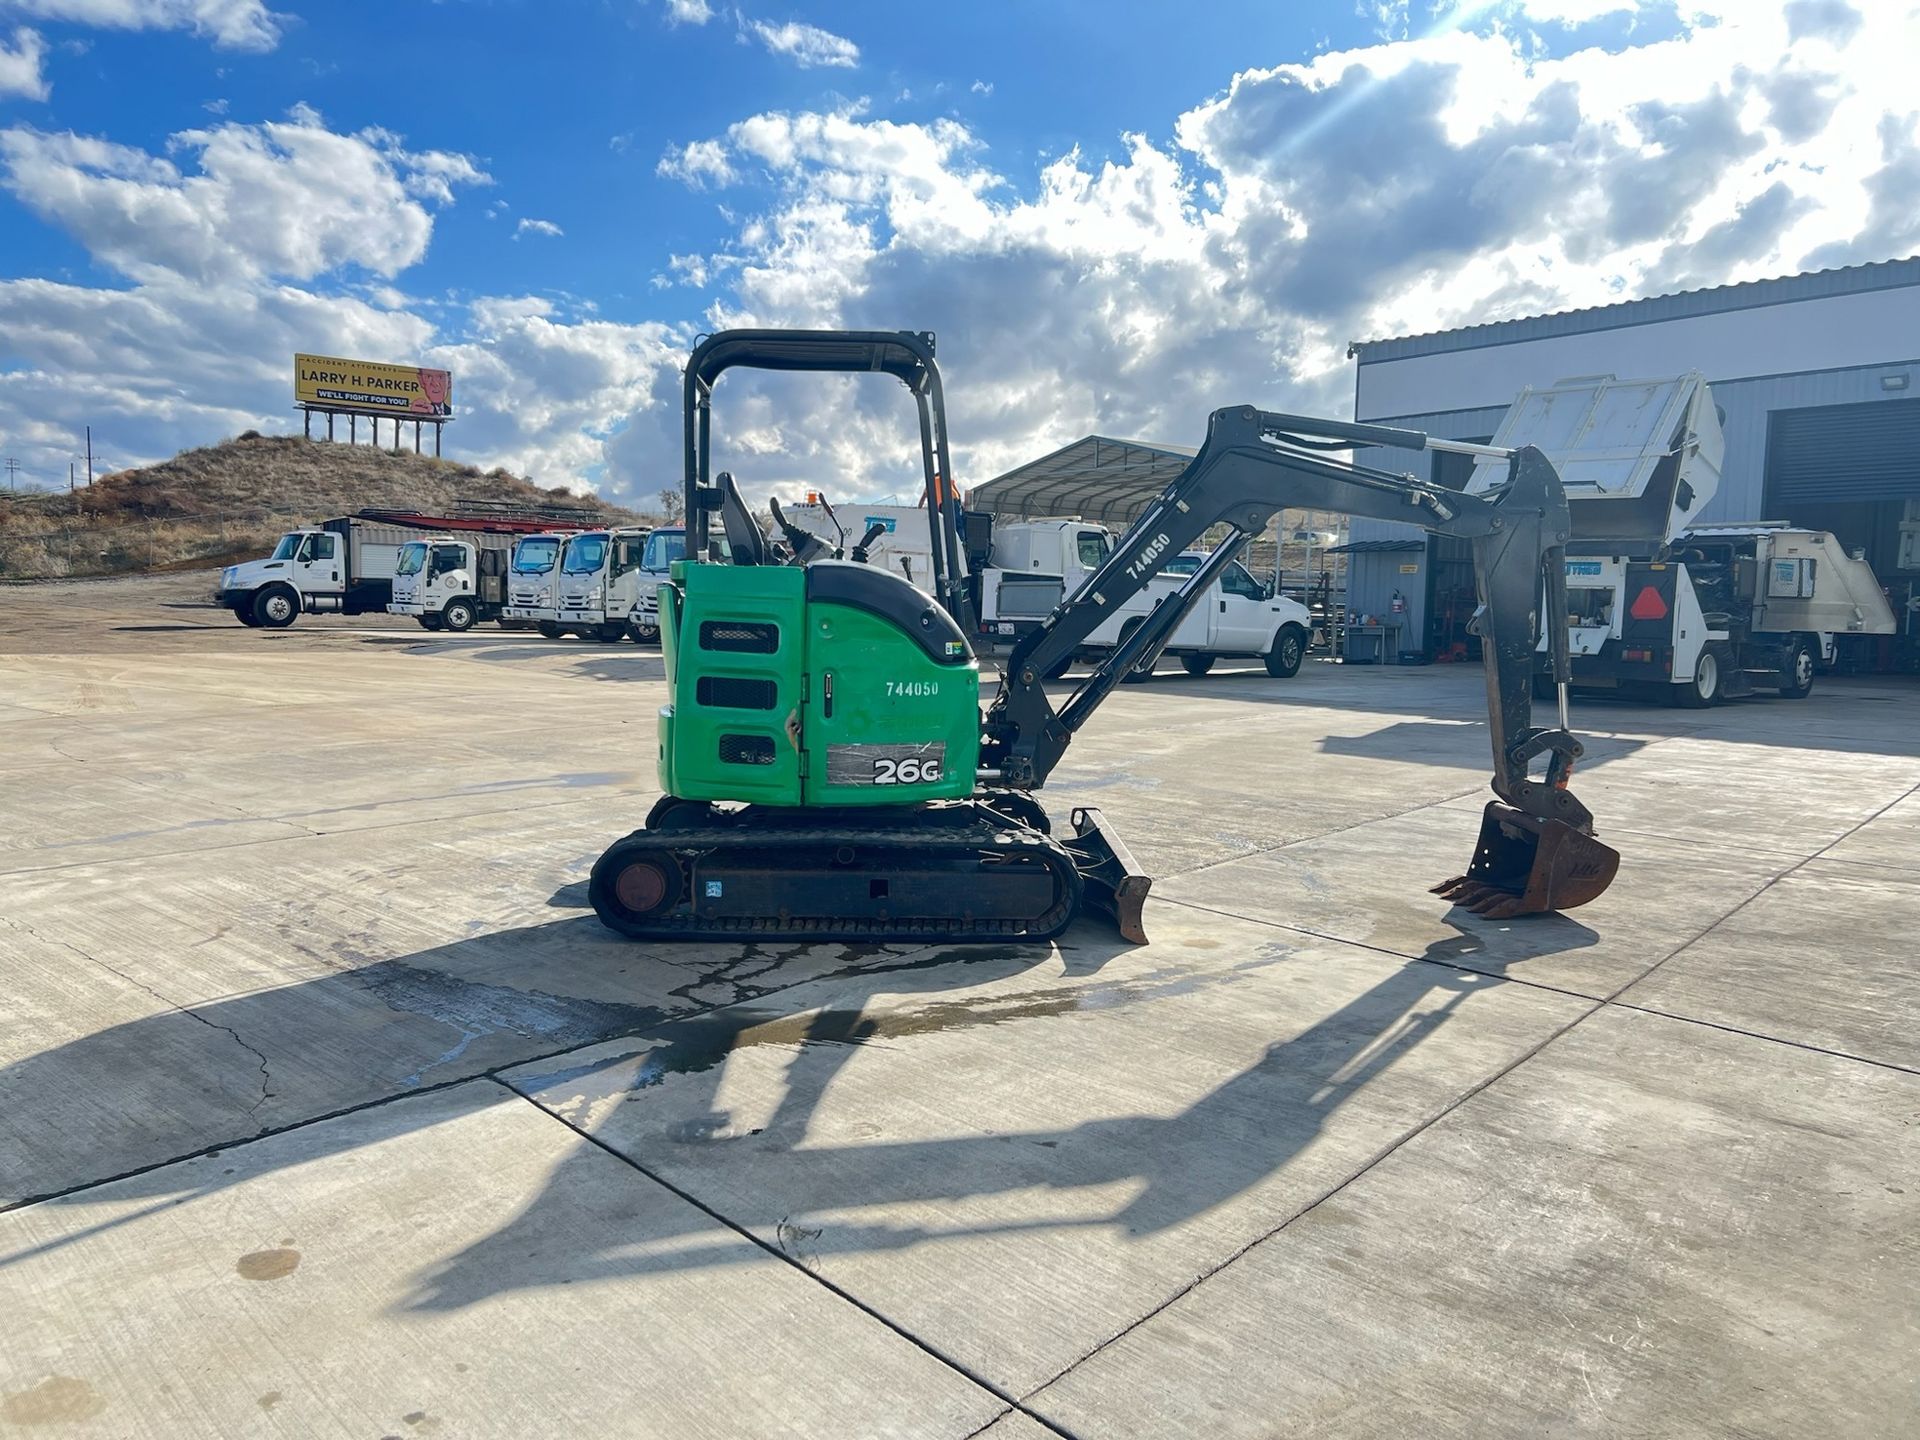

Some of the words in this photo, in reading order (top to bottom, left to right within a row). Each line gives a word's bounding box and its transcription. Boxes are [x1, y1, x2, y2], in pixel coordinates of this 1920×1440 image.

[306, 358, 347, 367] ACCIDENT
[351, 364, 398, 373] ATTORNEYS
[301, 370, 347, 384] LARRY
[352, 375, 364, 387] H.
[367, 377, 419, 392] PARKER
[318, 390, 344, 399] WE'LL
[345, 393, 369, 402] FIGHT
[371, 396, 387, 404] FOR
[388, 397, 408, 405] YOU!
[1126, 533, 1171, 579] 744050
[886, 682, 939, 697] 744050
[873, 757, 939, 785] 26G
